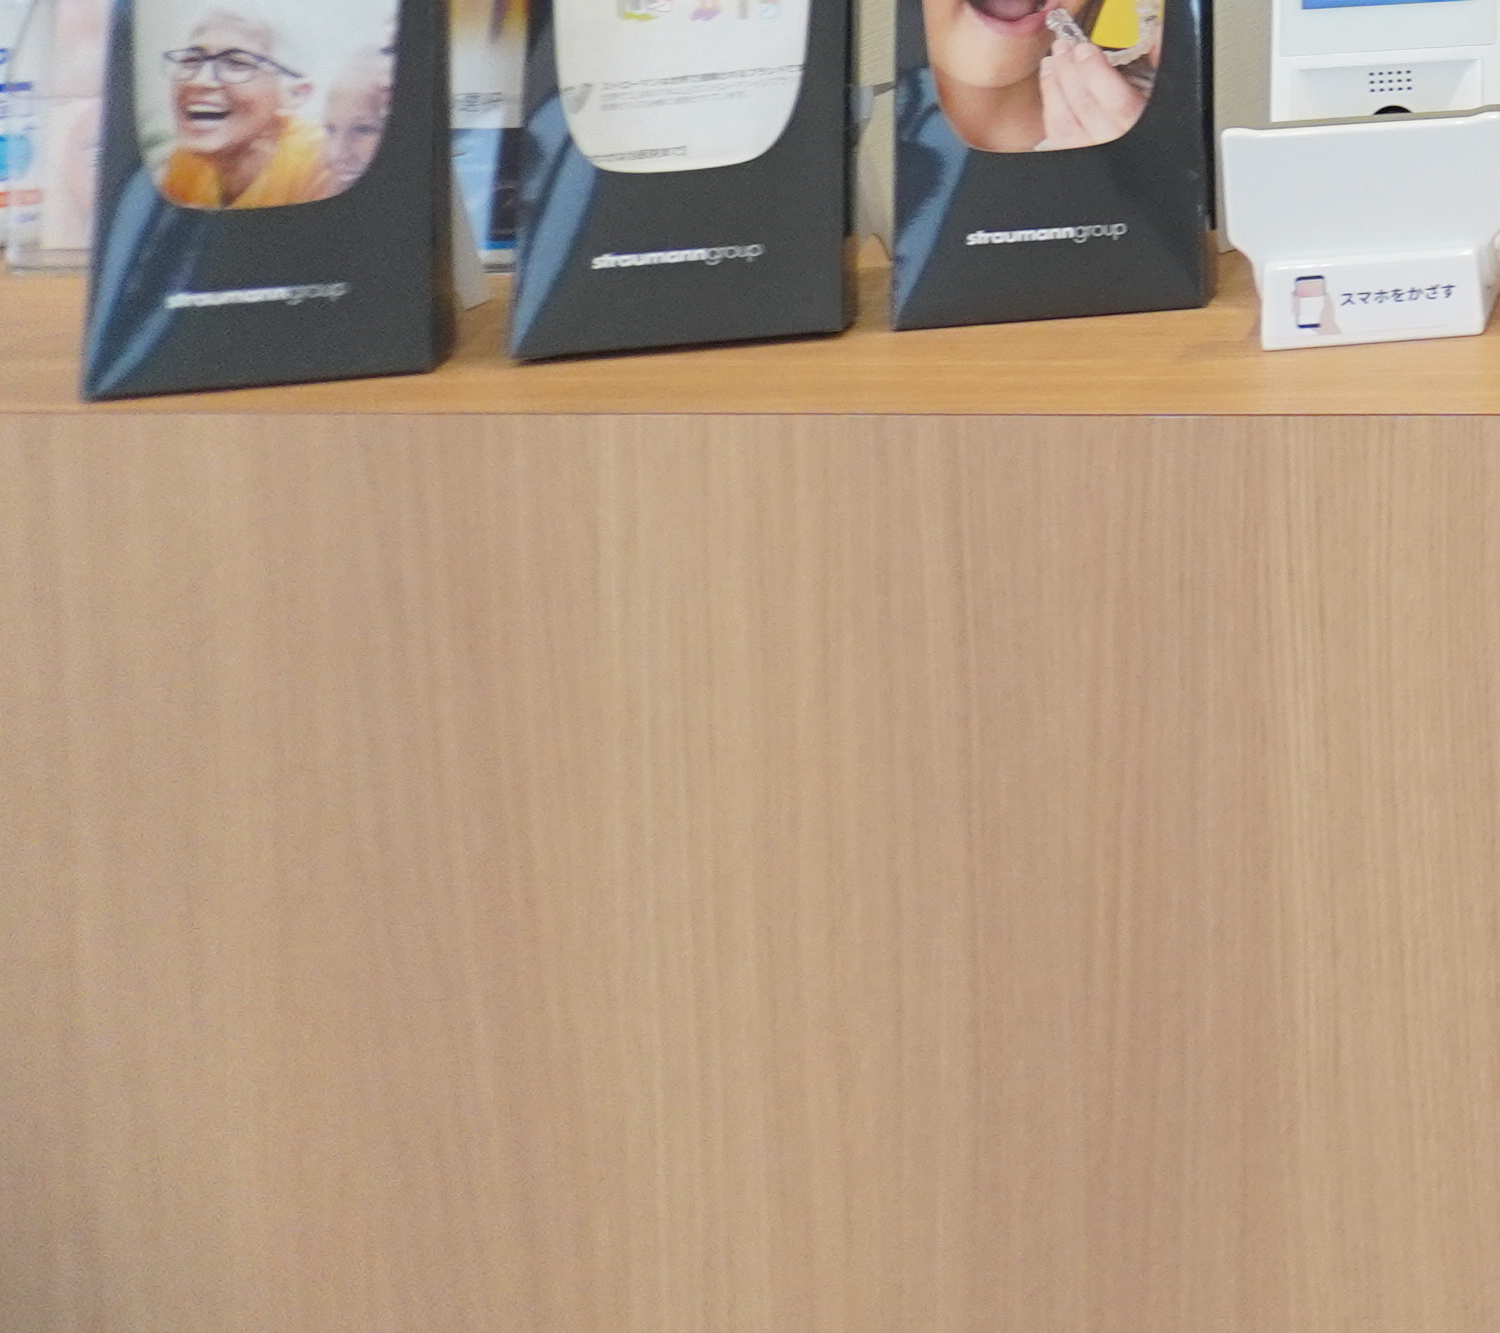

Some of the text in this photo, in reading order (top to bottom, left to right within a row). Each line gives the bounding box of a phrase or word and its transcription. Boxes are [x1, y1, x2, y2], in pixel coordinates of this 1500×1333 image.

[1340, 284, 1457, 307] スマホをかざす
